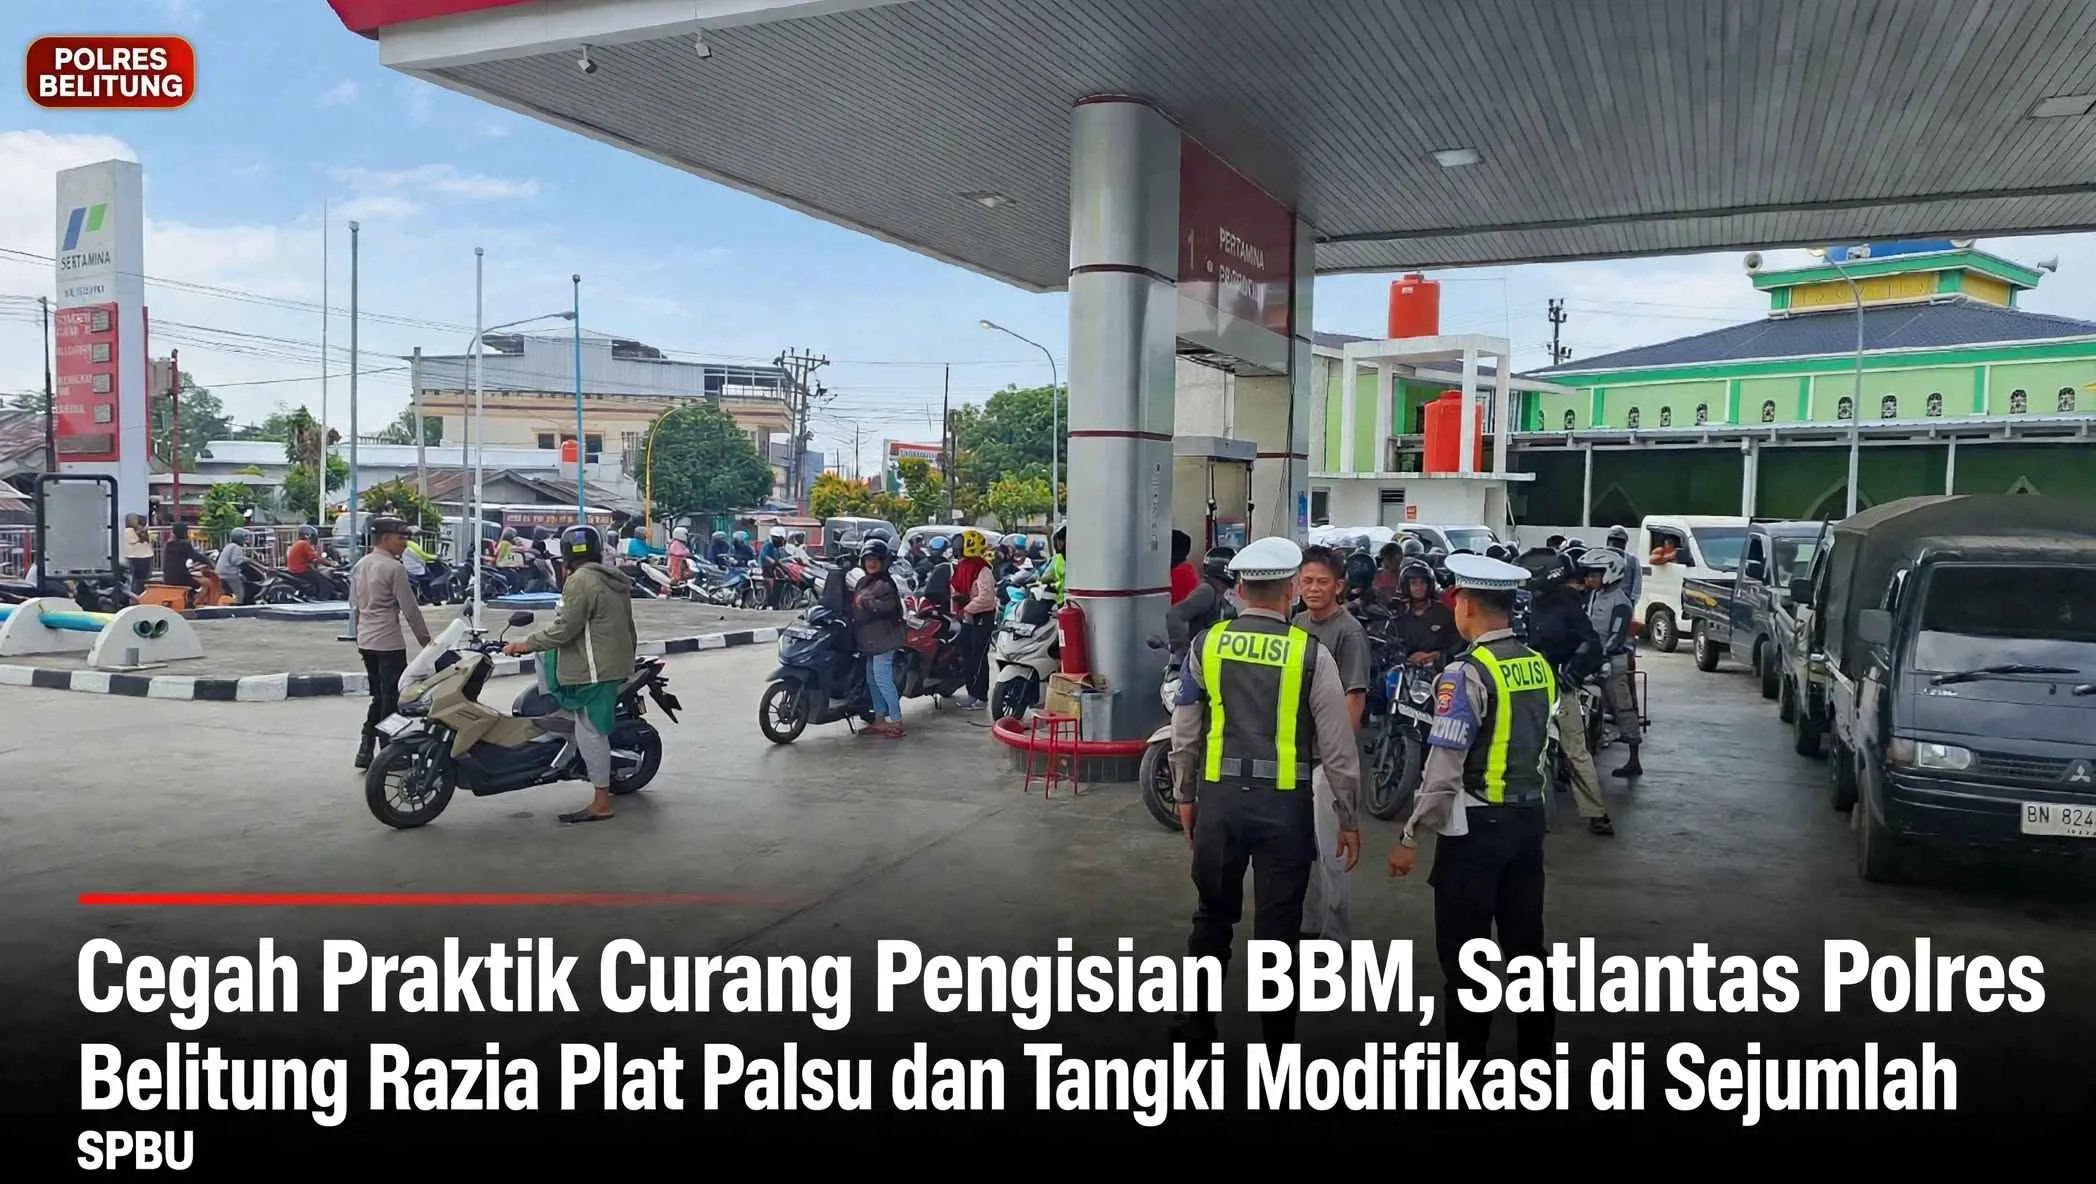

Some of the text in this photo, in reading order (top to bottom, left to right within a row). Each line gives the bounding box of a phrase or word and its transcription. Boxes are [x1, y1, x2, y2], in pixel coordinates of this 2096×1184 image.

[1216, 633, 1291, 665] POLISI
[1502, 660, 1549, 688] POLISI
[2027, 805, 2050, 824] BN
